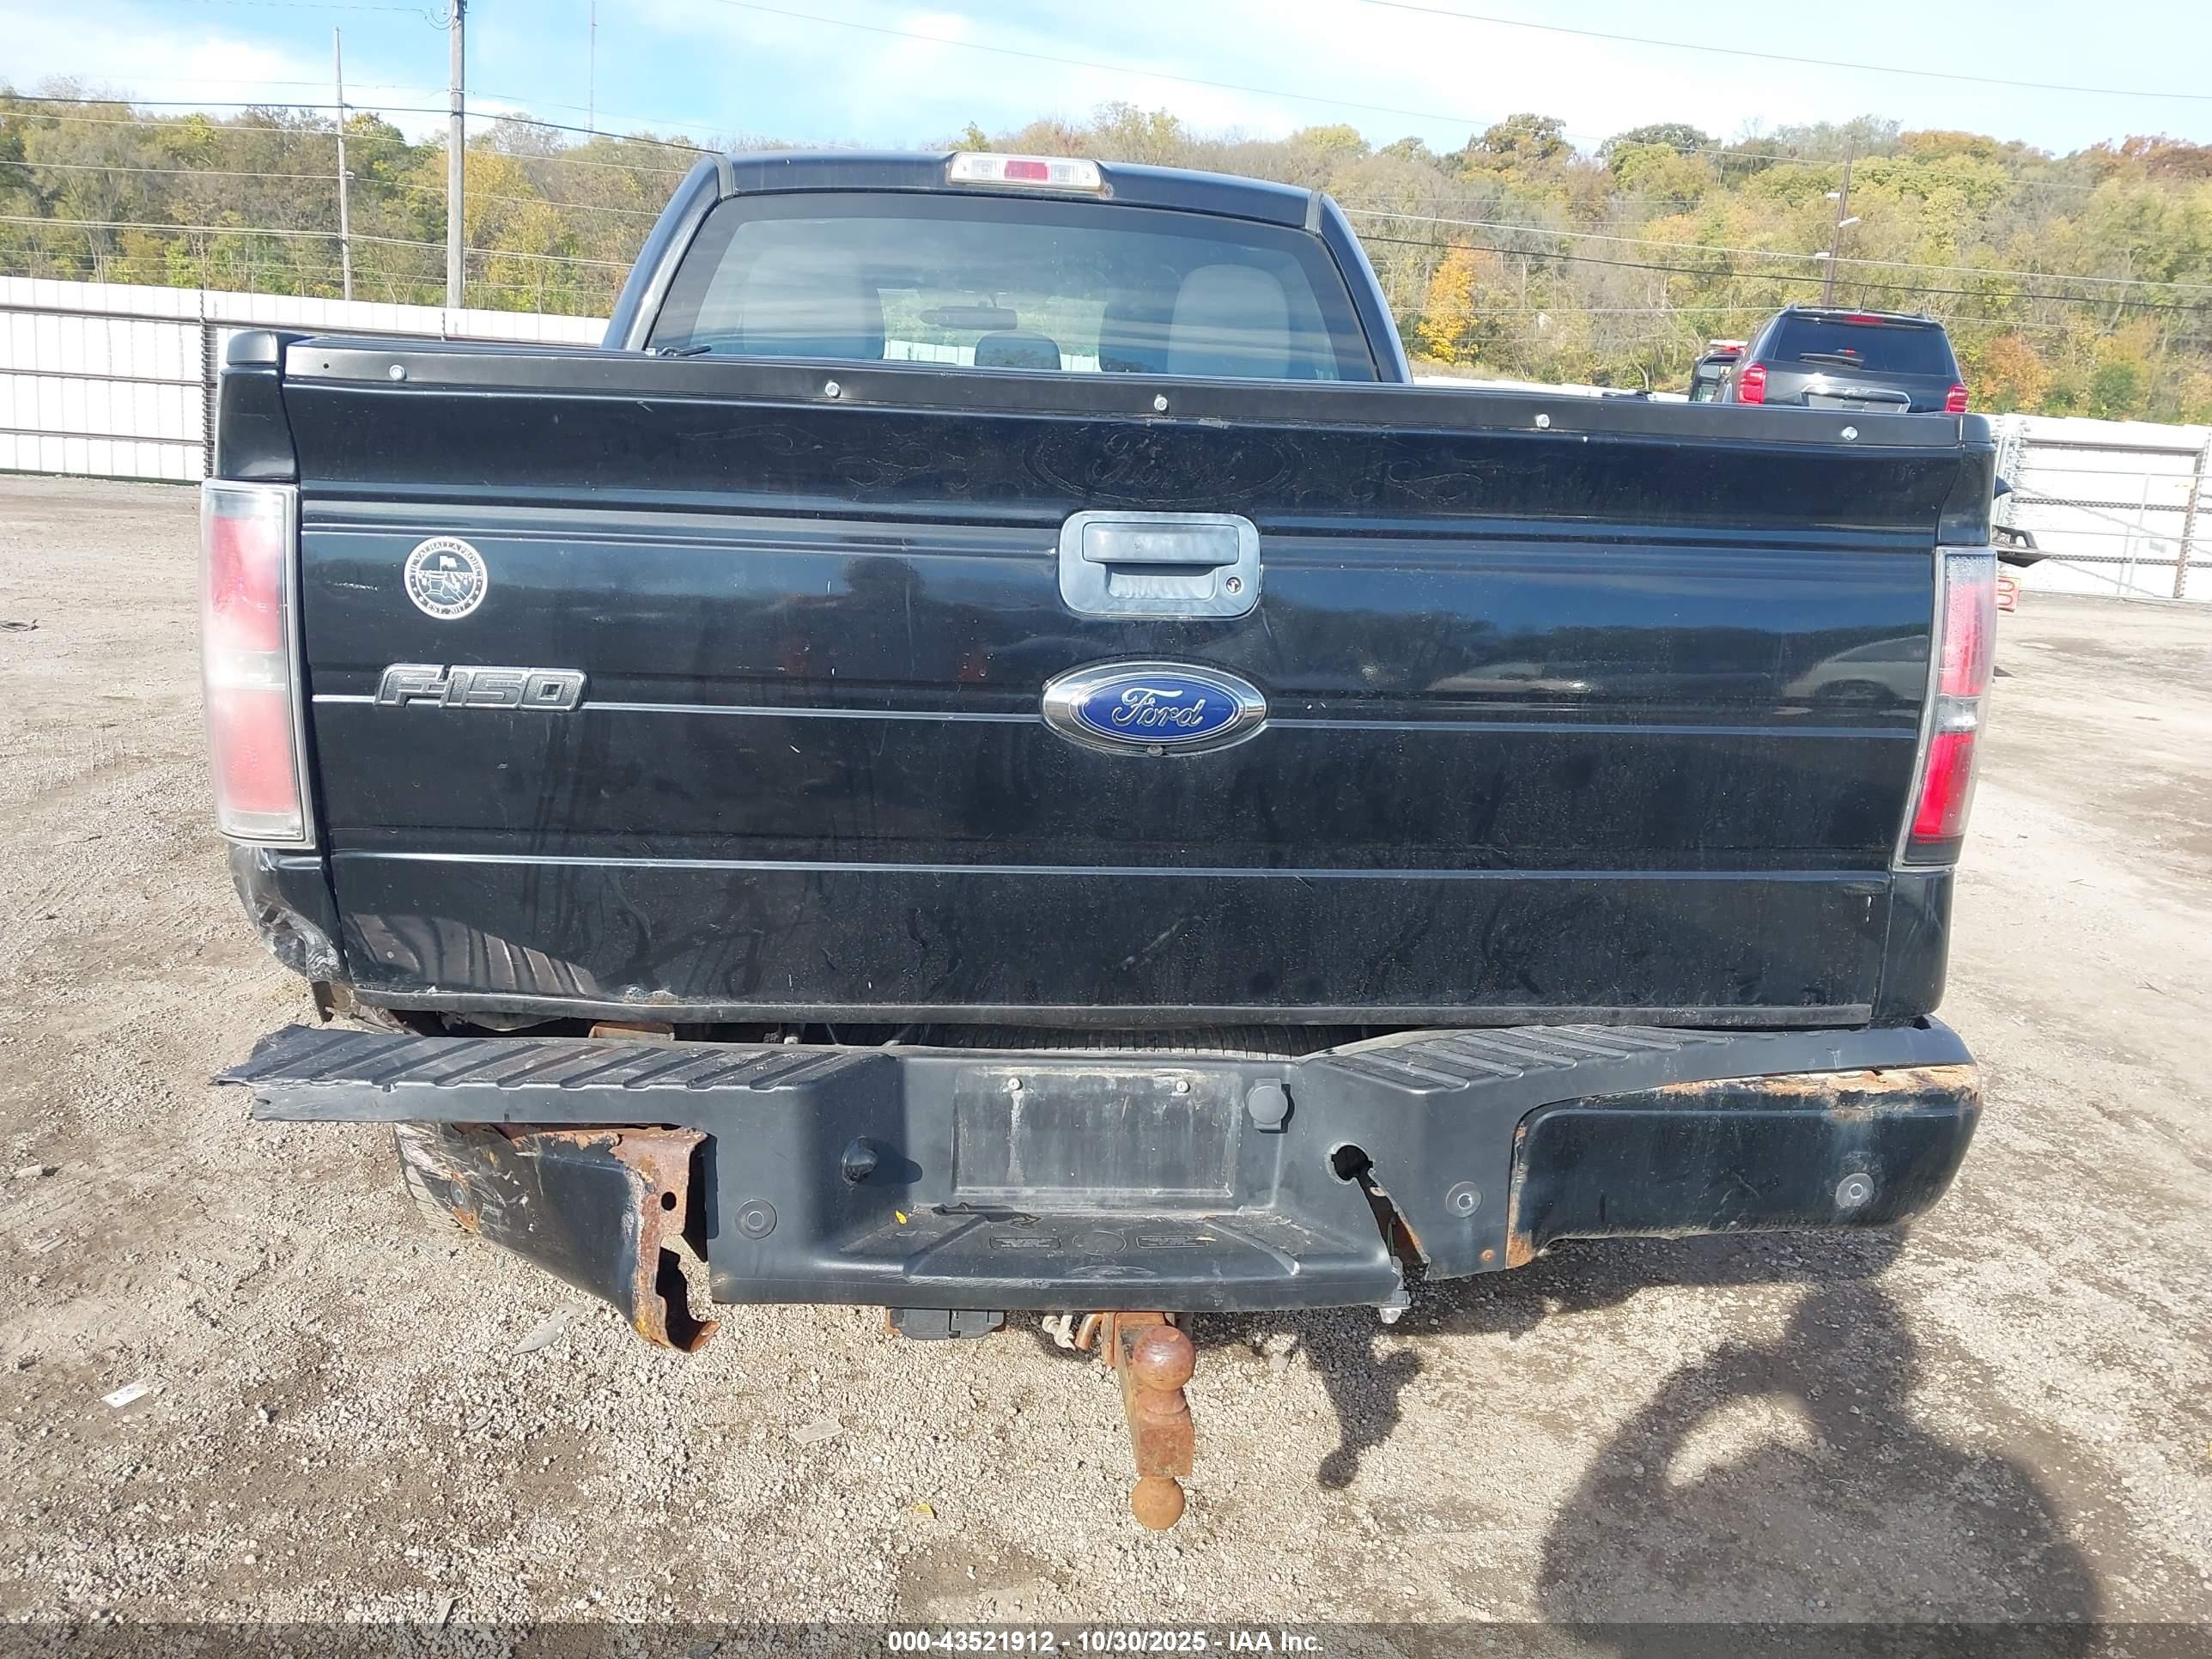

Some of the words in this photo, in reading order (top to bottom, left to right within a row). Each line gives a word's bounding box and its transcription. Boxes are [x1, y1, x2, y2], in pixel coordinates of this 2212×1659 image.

[461, 545, 483, 579] PROJECT
[374, 664, 587, 711] F-150
[1112, 688, 1206, 726] Ford
